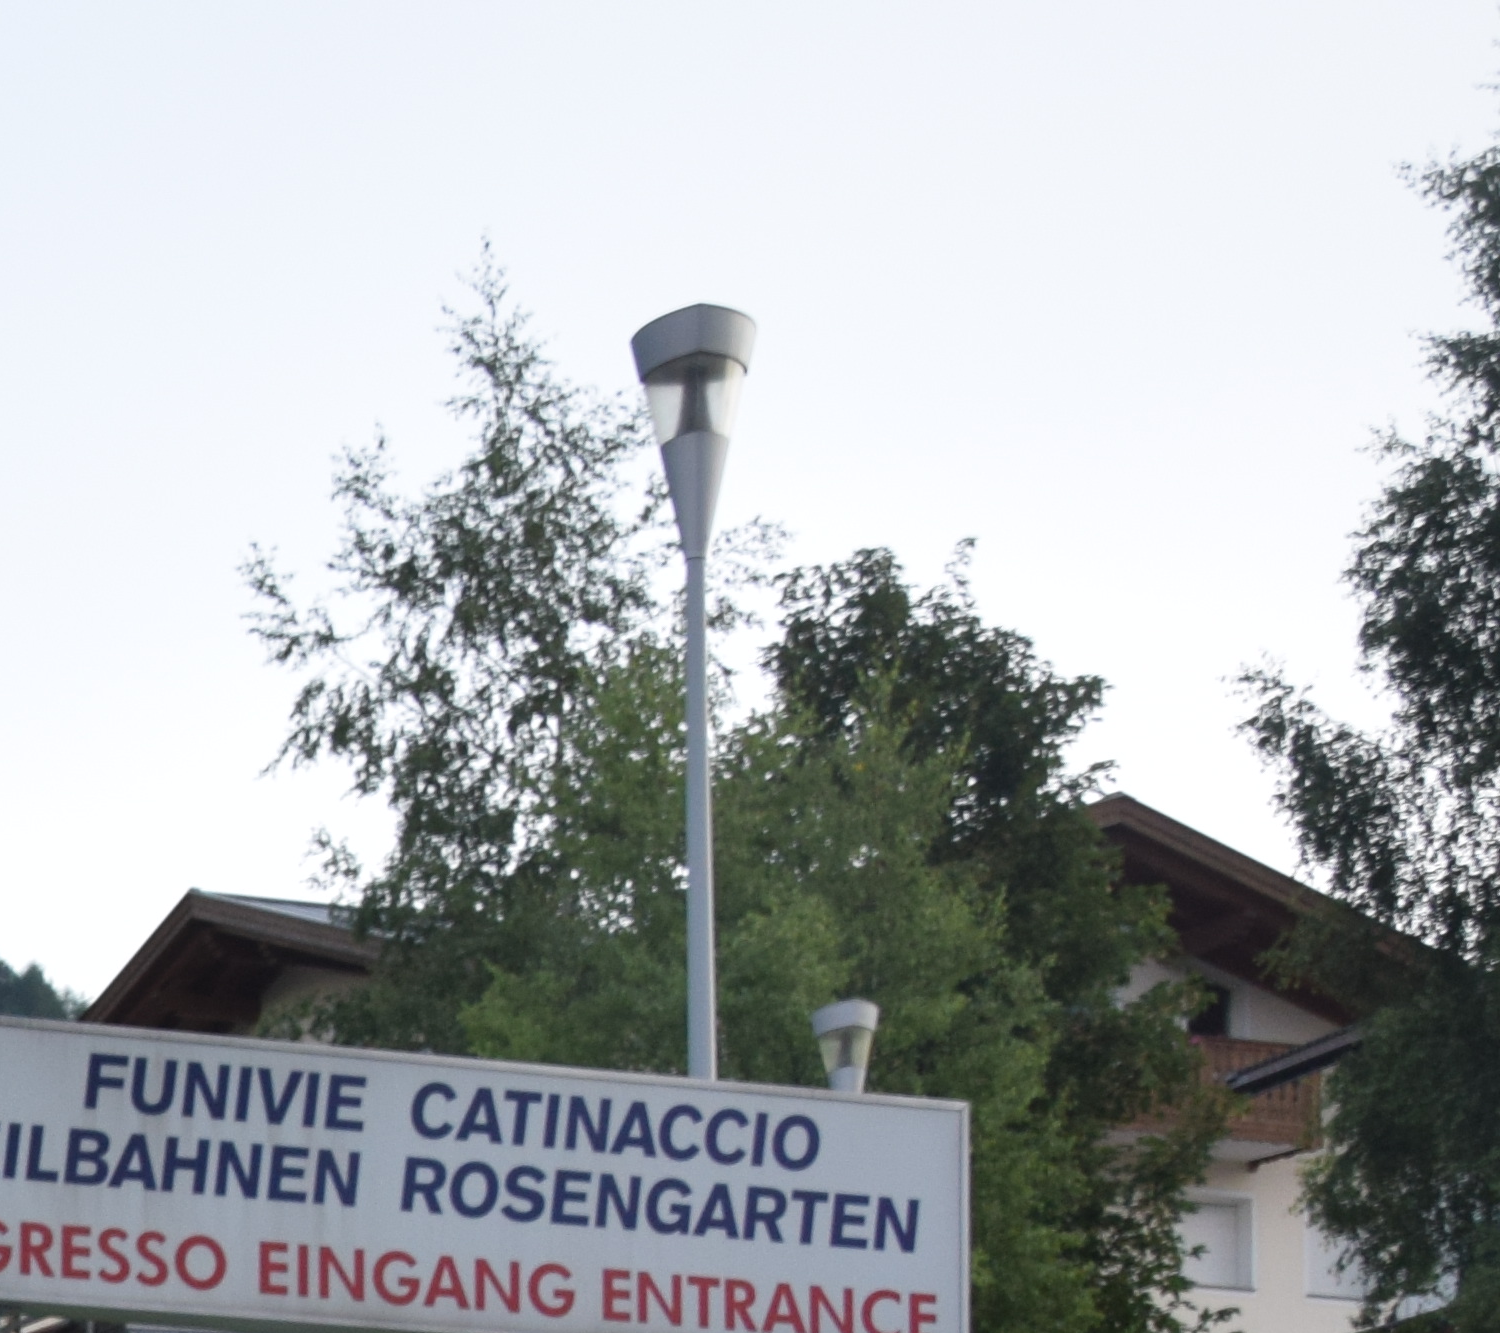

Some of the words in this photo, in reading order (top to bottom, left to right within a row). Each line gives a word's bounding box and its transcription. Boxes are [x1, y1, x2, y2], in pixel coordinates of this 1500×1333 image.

[84, 1054, 367, 1133] FUNIVIE
[410, 1083, 820, 1171] CATINACCIO
[400, 1156, 920, 1254] ROSENGARTEN
[258, 1240, 575, 1320] EINGANG
